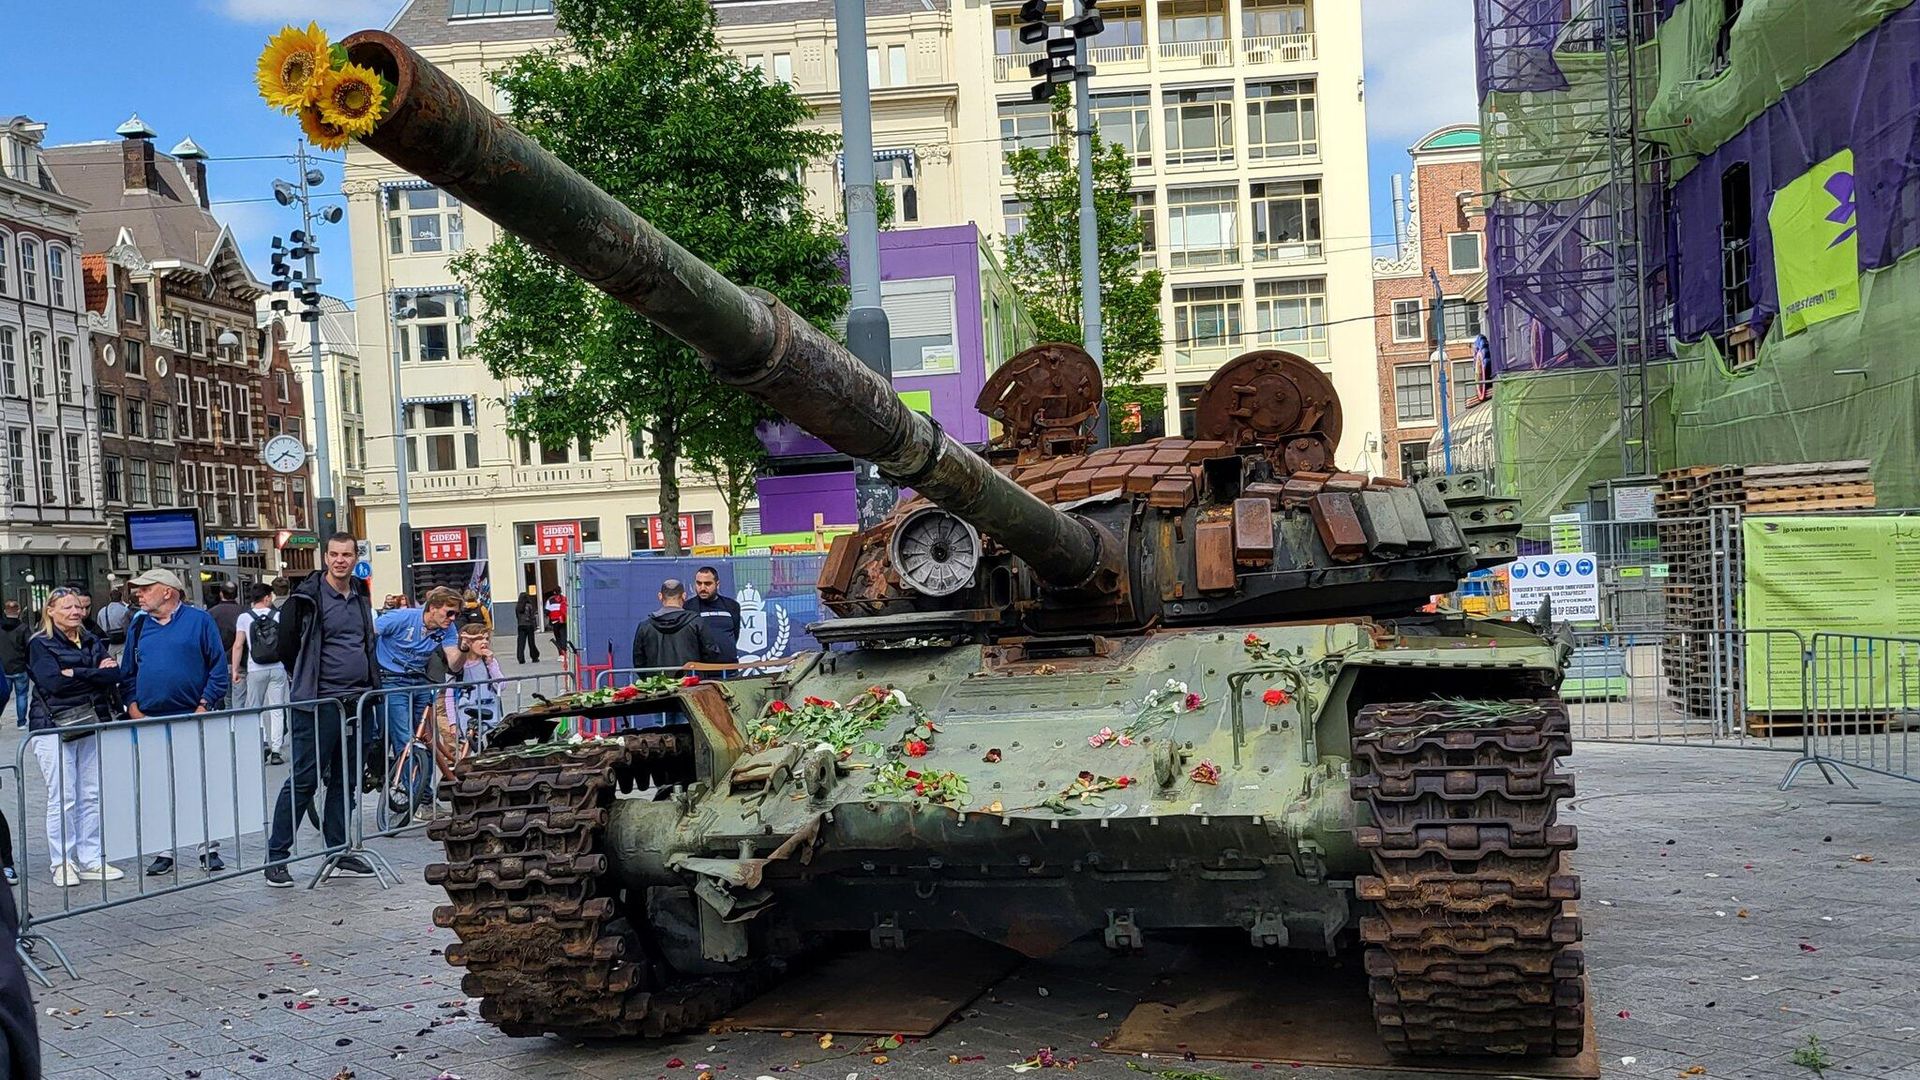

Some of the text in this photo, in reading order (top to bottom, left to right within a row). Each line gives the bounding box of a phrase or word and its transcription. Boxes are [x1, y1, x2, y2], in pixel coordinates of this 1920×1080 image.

[543, 526, 575, 535] GIDEON
[1782, 526, 1790, 534] jp
[429, 534, 462, 542] GIDEON
